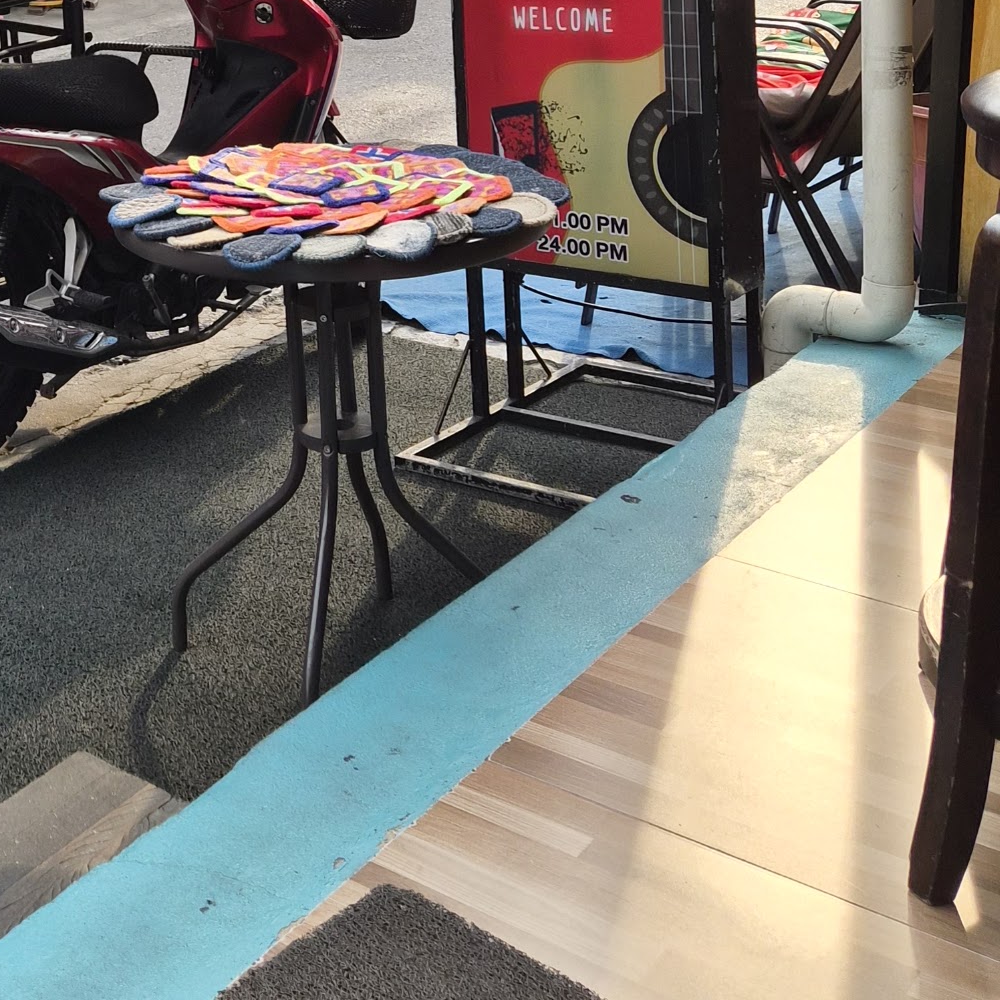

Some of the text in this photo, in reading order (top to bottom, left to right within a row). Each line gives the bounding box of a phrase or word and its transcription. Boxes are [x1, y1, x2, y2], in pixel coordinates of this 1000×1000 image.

[513, 5, 613, 33] WELCOME
[597, 215, 629, 236] PM
[537, 236, 629, 262] 24.00 PM
